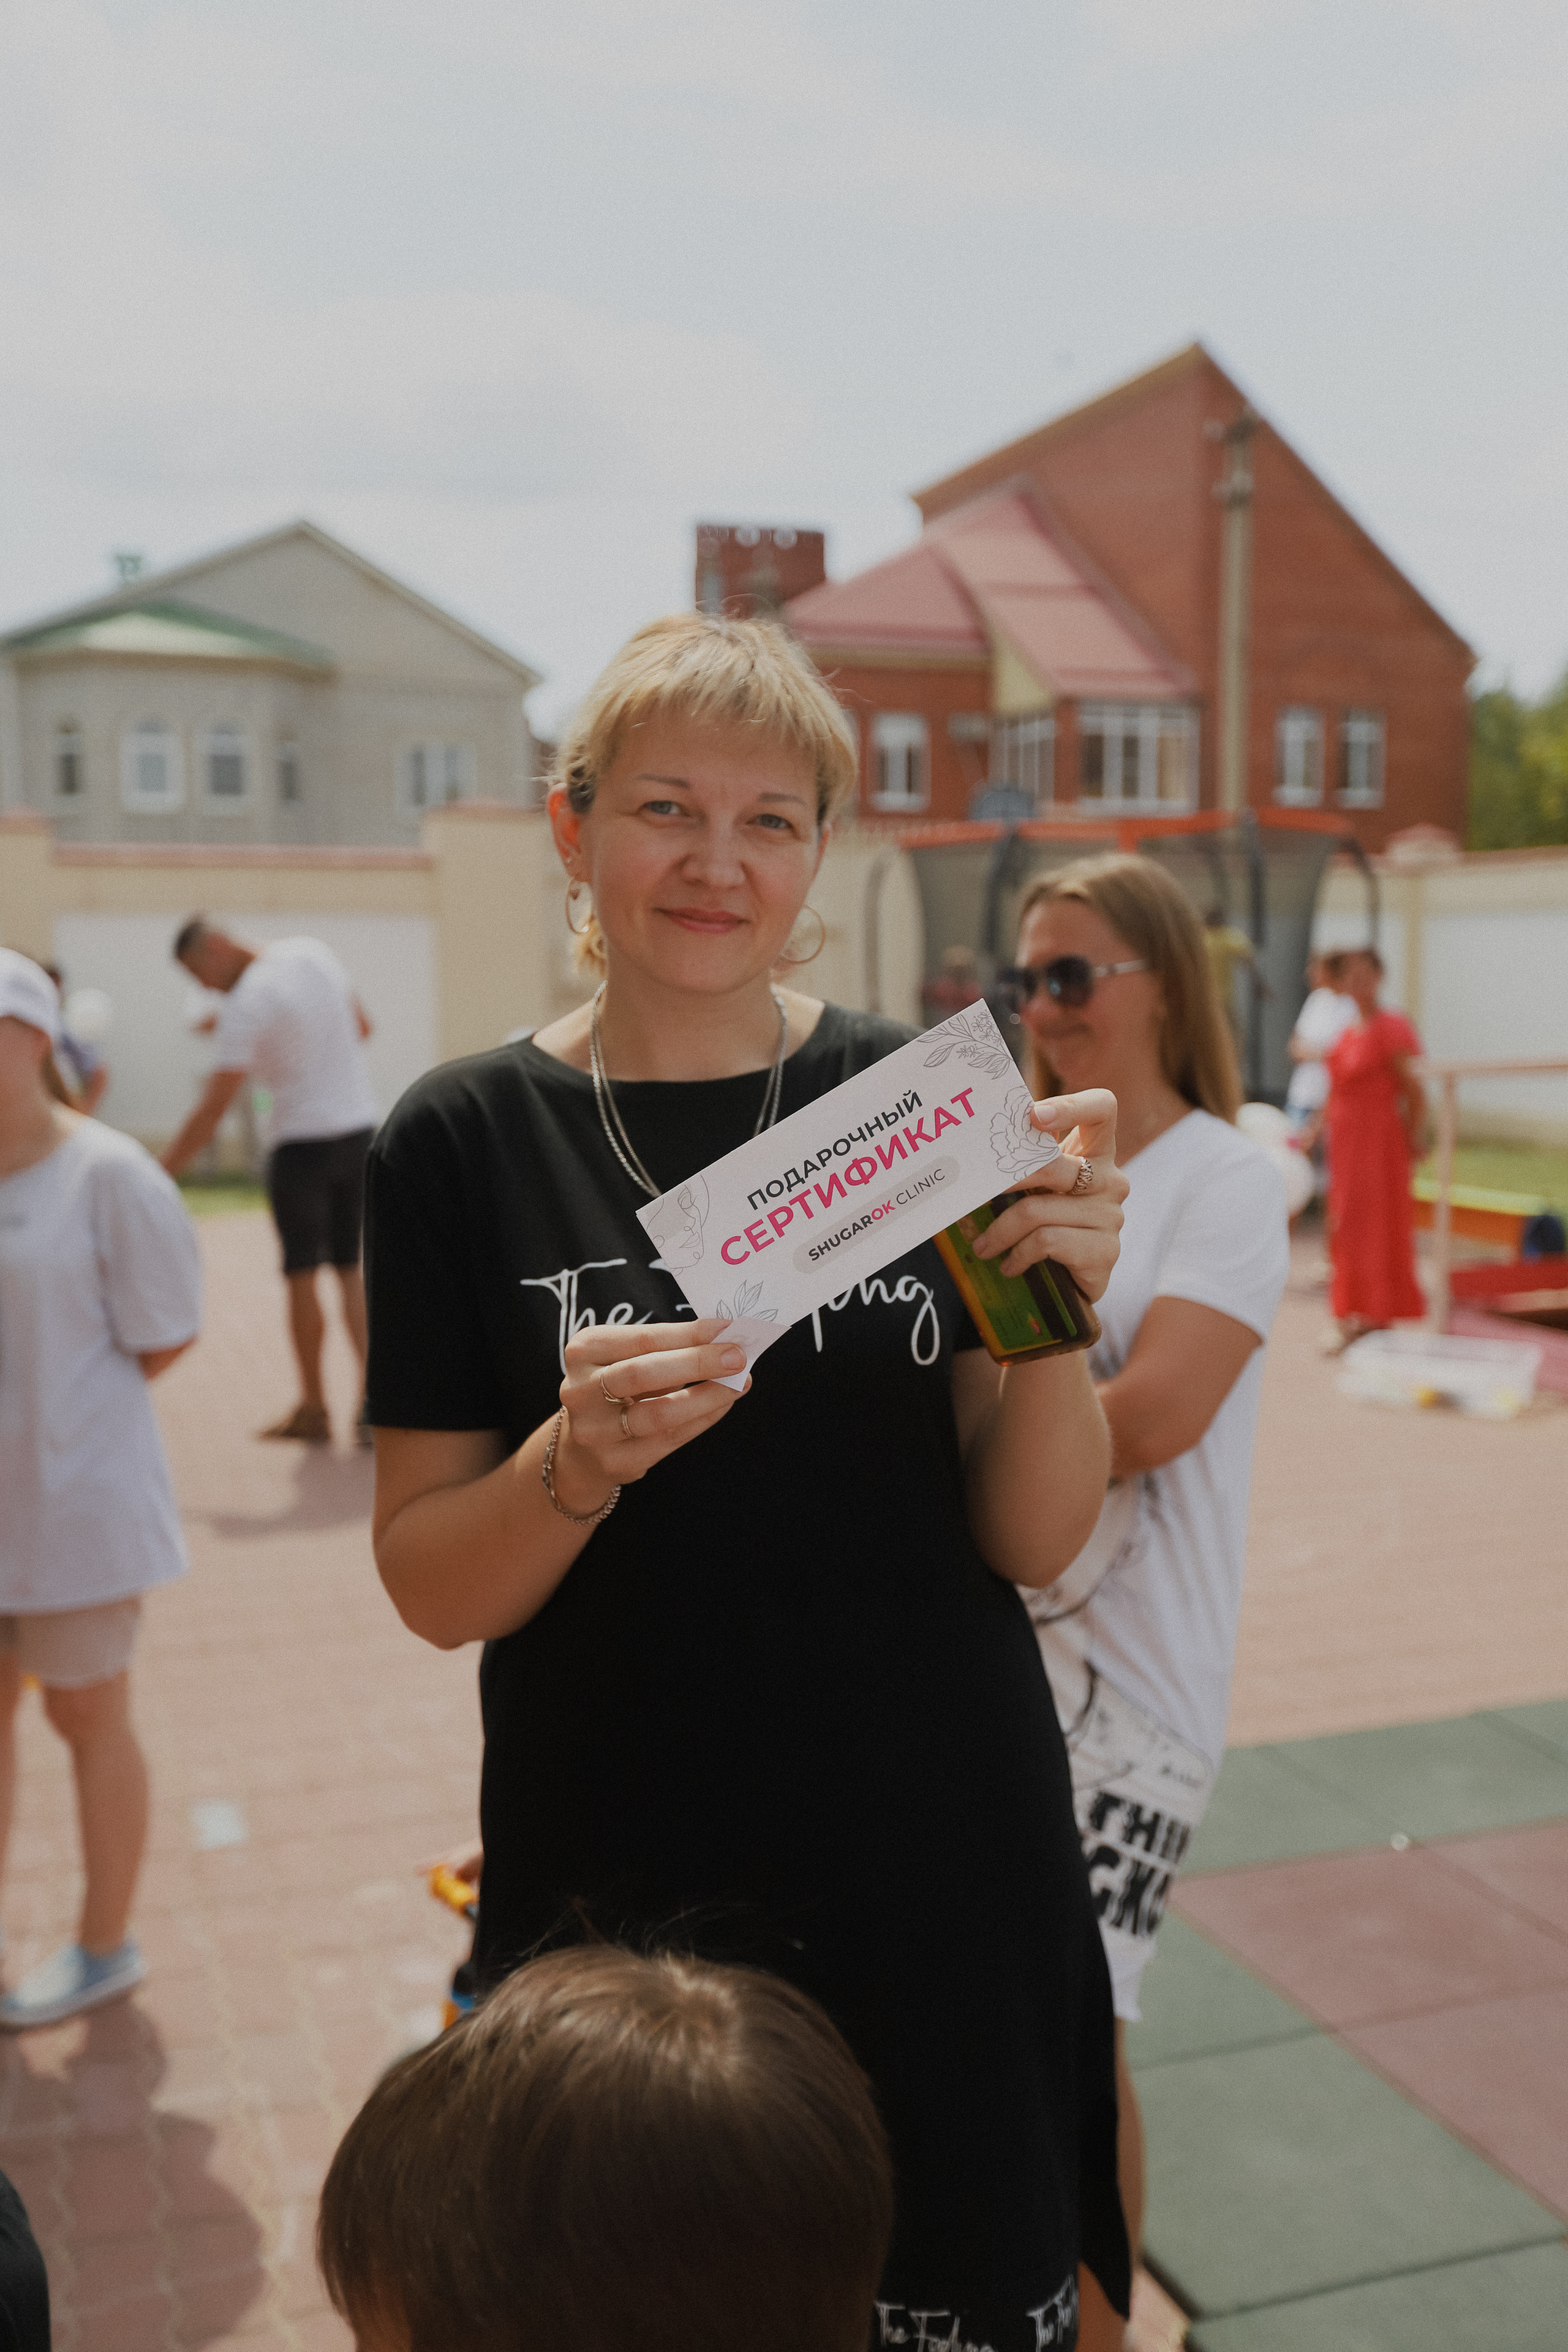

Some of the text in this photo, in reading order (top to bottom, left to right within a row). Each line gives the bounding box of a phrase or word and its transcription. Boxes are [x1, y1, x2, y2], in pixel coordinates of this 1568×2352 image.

[720, 1087, 975, 1265] СЕРТИФИКАТ
[747, 1089, 923, 1211] ПОДАРОЧНЫЙ
[808, 1168, 946, 1261] SHUGAROK CLINIC
